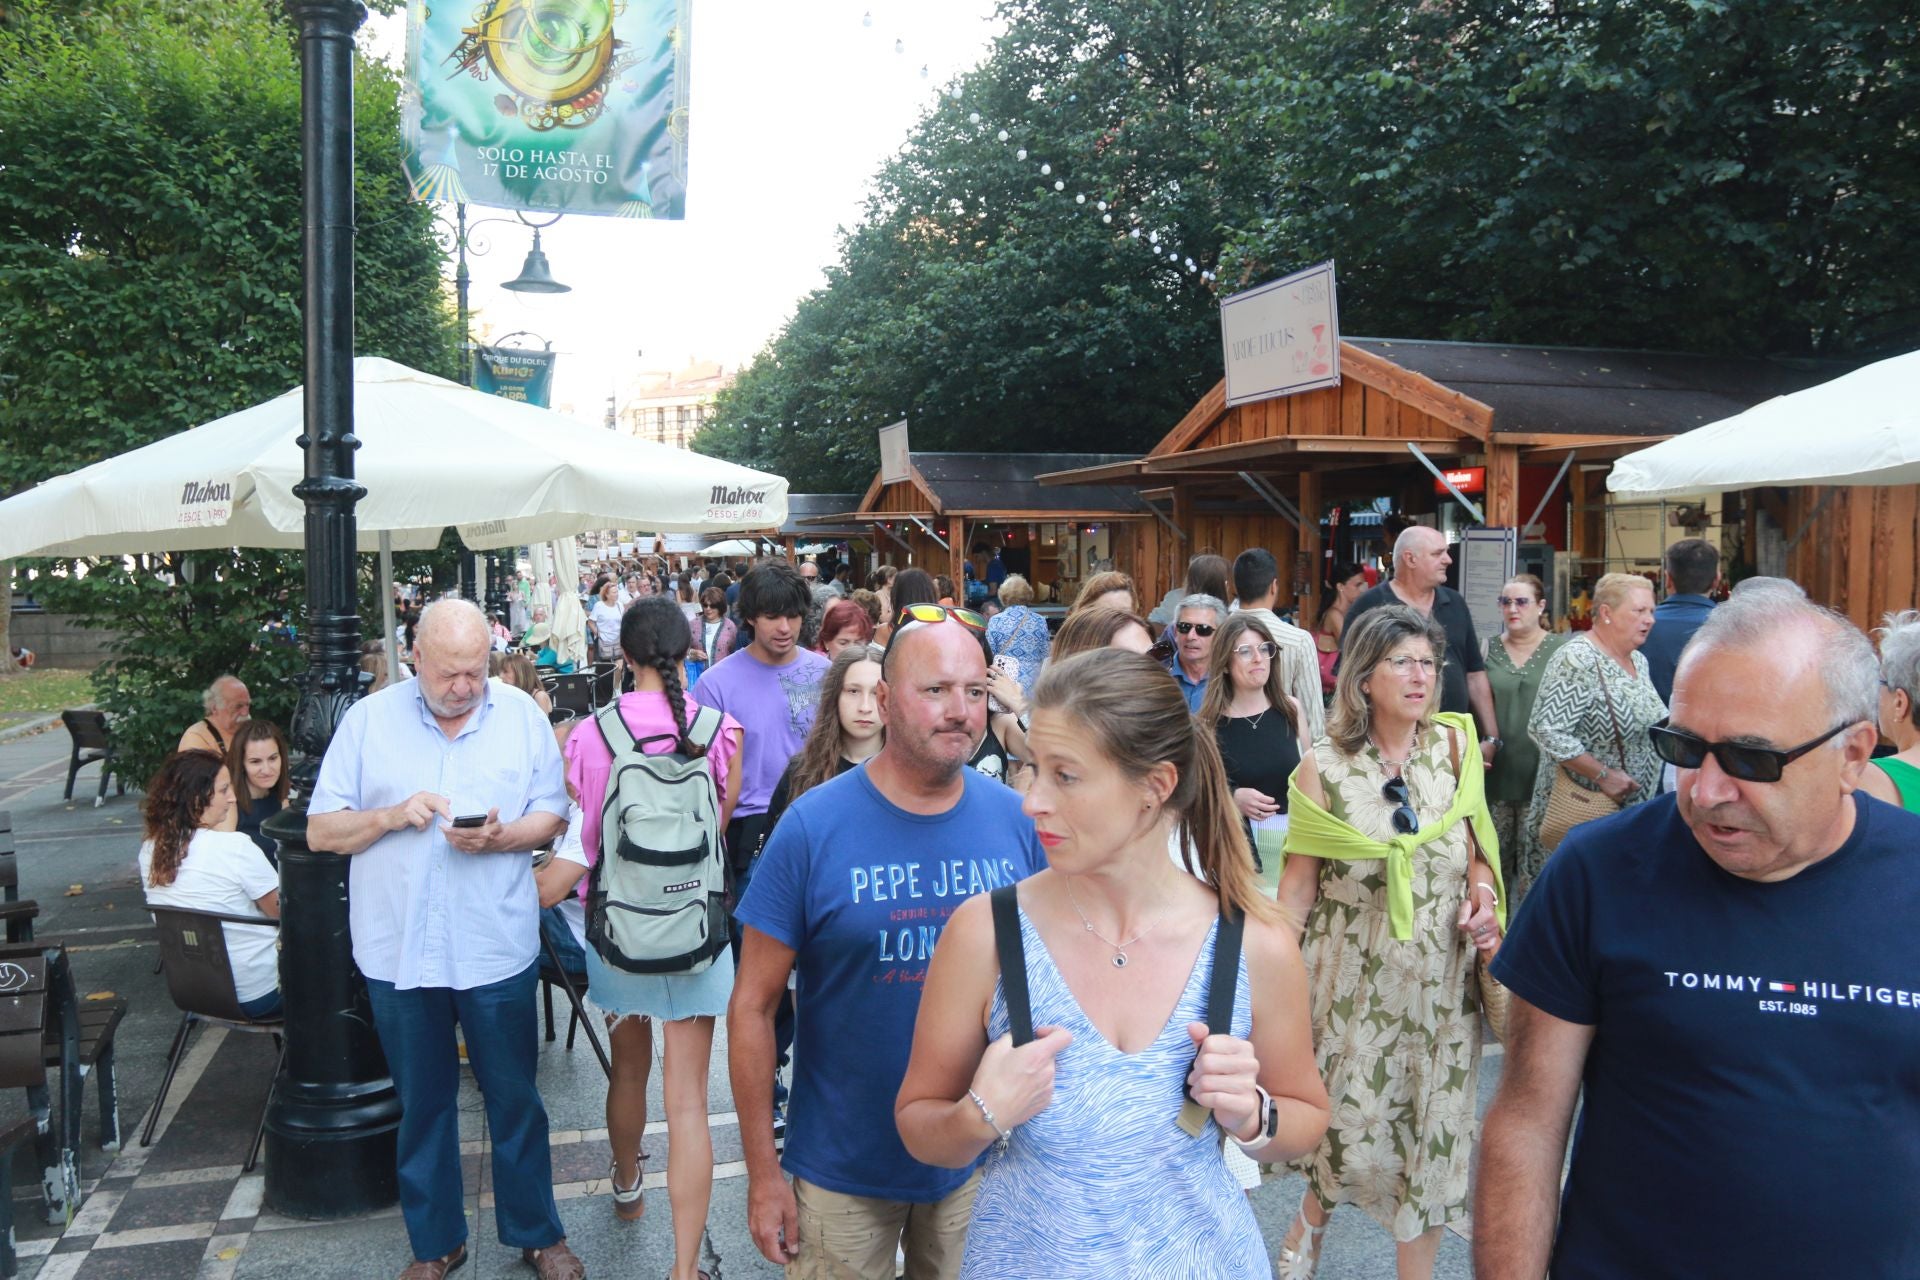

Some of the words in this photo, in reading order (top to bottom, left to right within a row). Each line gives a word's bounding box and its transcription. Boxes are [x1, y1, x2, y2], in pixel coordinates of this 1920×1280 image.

[477, 147, 523, 162] SOLO
[530, 150, 589, 166] HASTA
[596, 154, 613, 168] EL
[483, 163, 498, 176] 17
[505, 164, 528, 178] DE
[533, 166, 607, 184] AGOSTO
[181, 480, 231, 504] Mahou
[710, 485, 765, 504] Mahou
[707, 509, 738, 518] DESDE
[666, 881, 698, 891] BURTON
[850, 862, 922, 903] PEPE
[932, 857, 1015, 897] JEANS
[879, 925, 946, 961] LON
[1664, 971, 1761, 993] TOMMY
[1759, 1000, 1787, 1013] EST.
[1789, 1002, 1817, 1016] 1985
